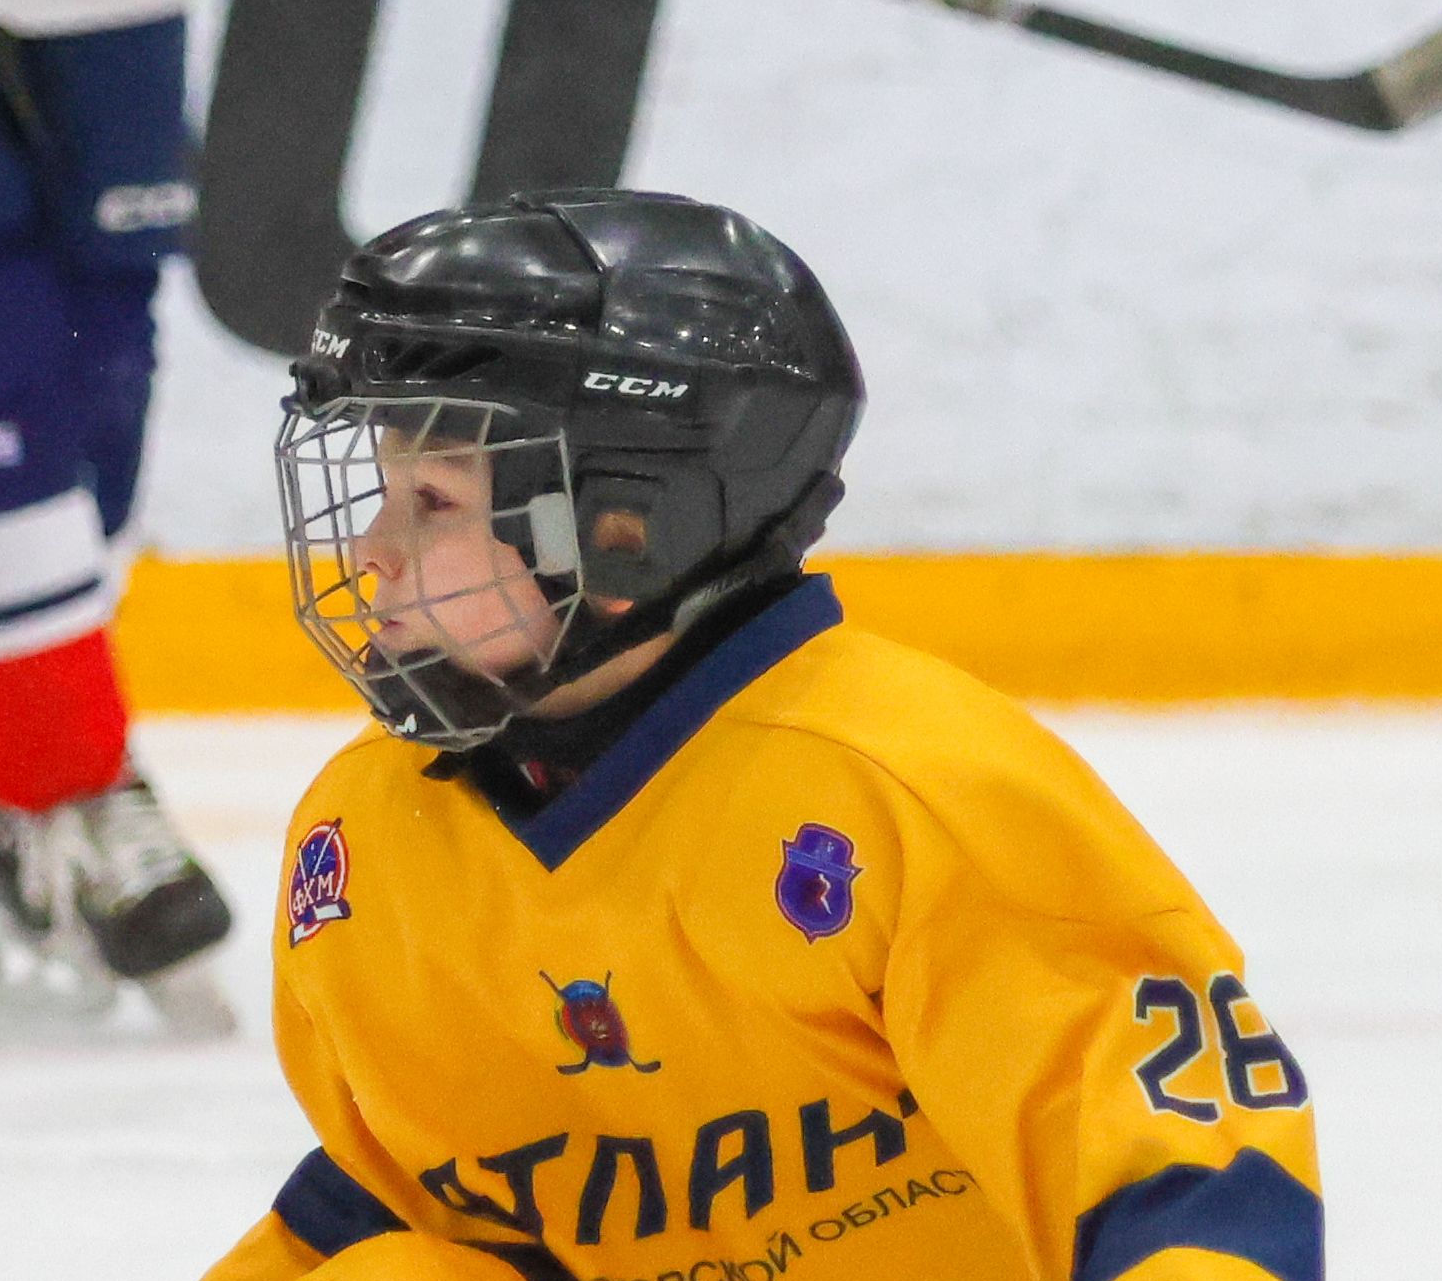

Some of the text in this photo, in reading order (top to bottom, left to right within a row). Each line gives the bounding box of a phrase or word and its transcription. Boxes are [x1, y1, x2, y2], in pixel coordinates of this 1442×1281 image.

[584, 371, 689, 399] CCM
[292, 870, 335, 917] ФХМ
[418, 1088, 920, 1246] АТЛАН
